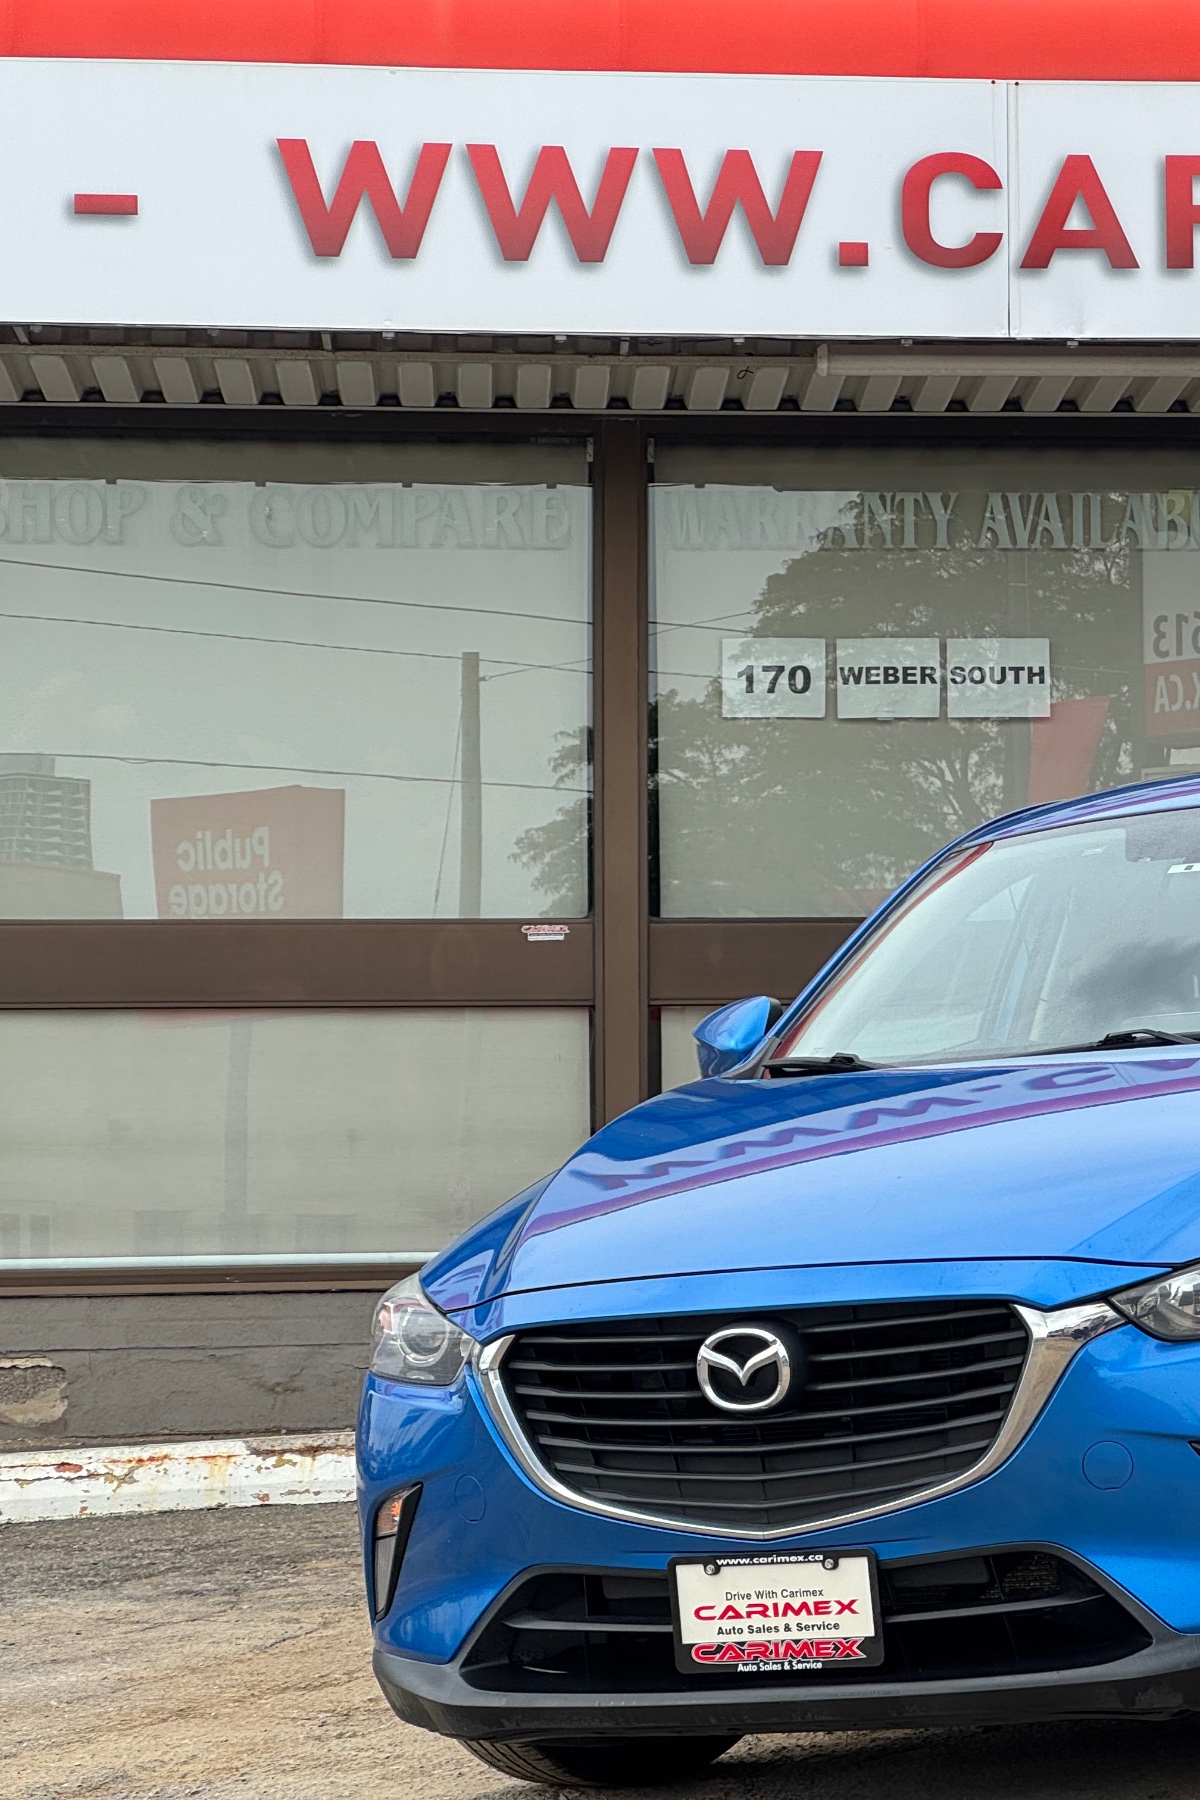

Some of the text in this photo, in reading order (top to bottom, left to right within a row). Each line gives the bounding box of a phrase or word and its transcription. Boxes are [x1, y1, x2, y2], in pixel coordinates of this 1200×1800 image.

[0, 482, 573, 551] HOP & COMPARE
[736, 664, 1046, 695] 170 WEBER SOUTH
[715, 1554, 824, 1566] www.carimex.ca
[725, 1588, 824, 1601] Drive With Carimex
[694, 1599, 860, 1621] CARIMEX
[717, 1621, 840, 1636] Auto Sales & Service
[691, 1638, 864, 1663] CARIMEX
[737, 1660, 823, 1672] Auto Sales & Service
